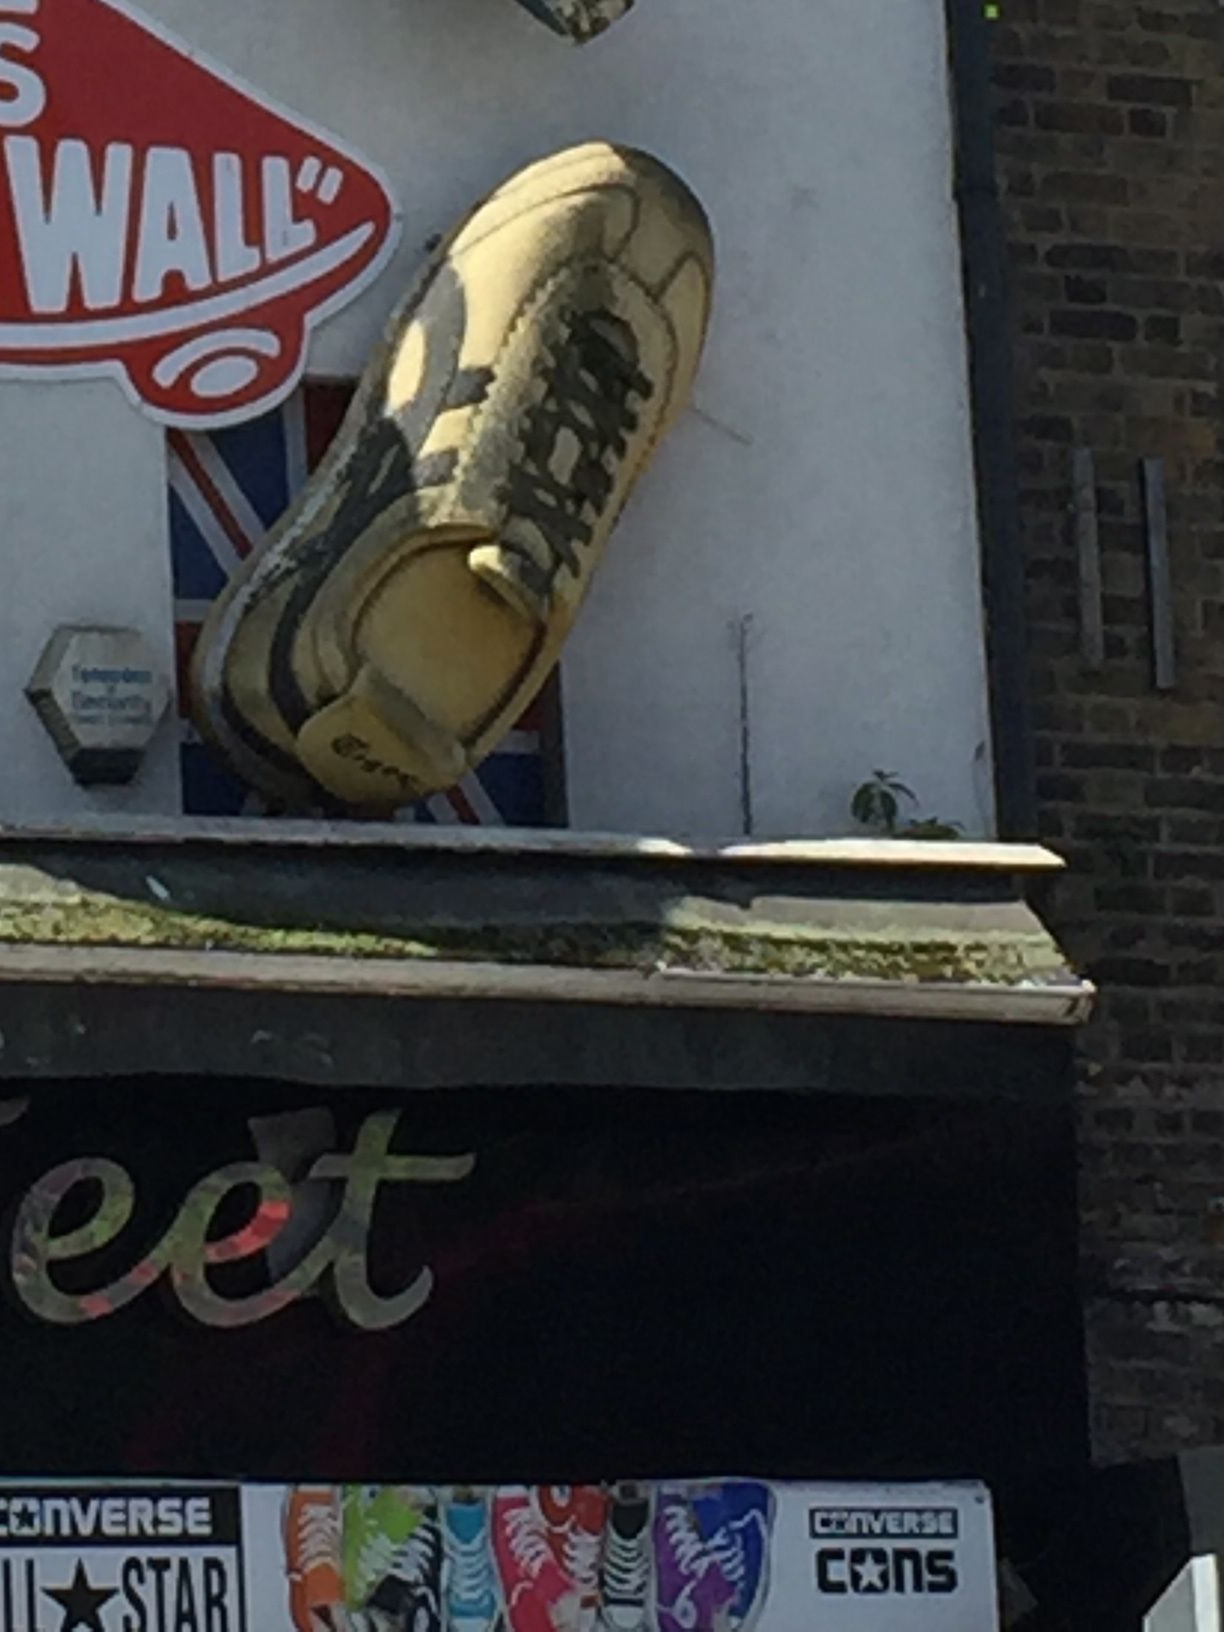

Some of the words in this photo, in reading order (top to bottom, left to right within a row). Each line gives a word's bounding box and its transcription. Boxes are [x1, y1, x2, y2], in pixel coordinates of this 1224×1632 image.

[813, 1511, 957, 1537] CONVERSE
[122, 1555, 229, 1632] STAR
[816, 1548, 959, 1594] CONS
